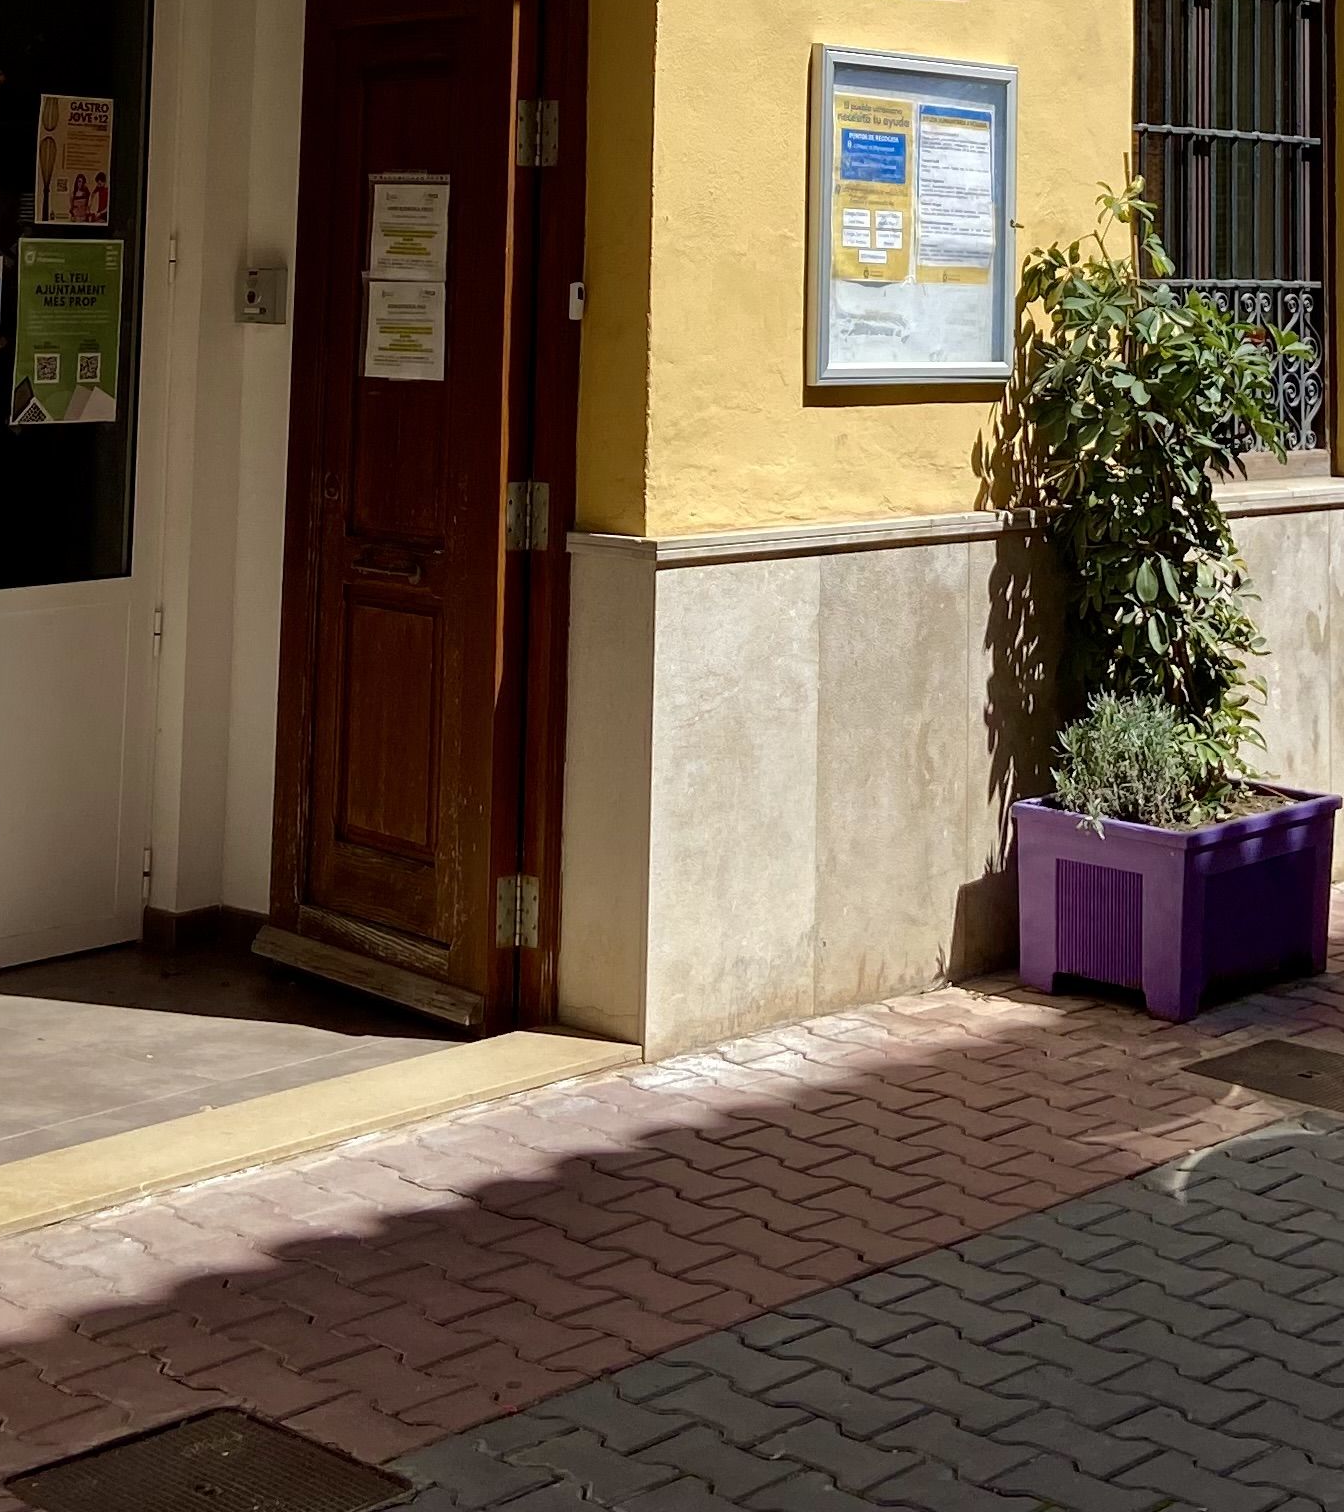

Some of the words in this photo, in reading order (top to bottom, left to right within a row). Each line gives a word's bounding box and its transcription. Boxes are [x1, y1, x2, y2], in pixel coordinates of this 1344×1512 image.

[70, 101, 110, 113] GASTRO
[54, 273, 66, 283] EL
[68, 272, 89, 283] TEU
[35, 284, 106, 296] AJUNTAMENT
[68, 296, 97, 307] PROP
